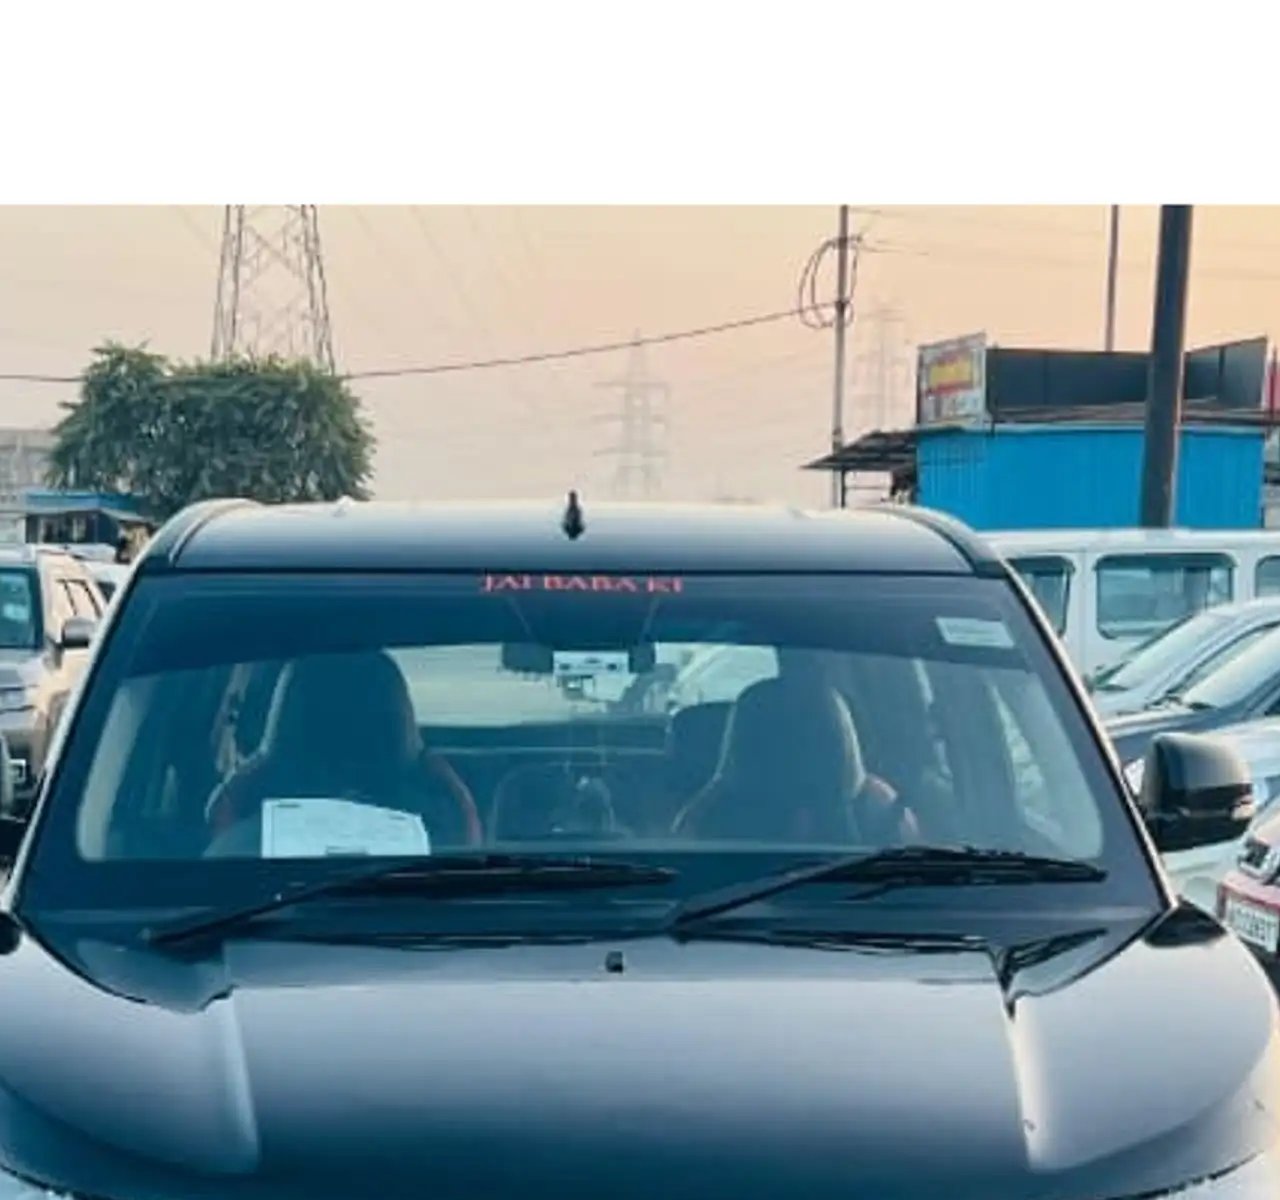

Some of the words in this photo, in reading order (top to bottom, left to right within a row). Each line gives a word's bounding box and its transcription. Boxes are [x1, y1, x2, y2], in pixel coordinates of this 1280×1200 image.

[482, 575, 531, 593] JAI
[544, 575, 637, 593] BABA
[647, 575, 683, 593] KI
